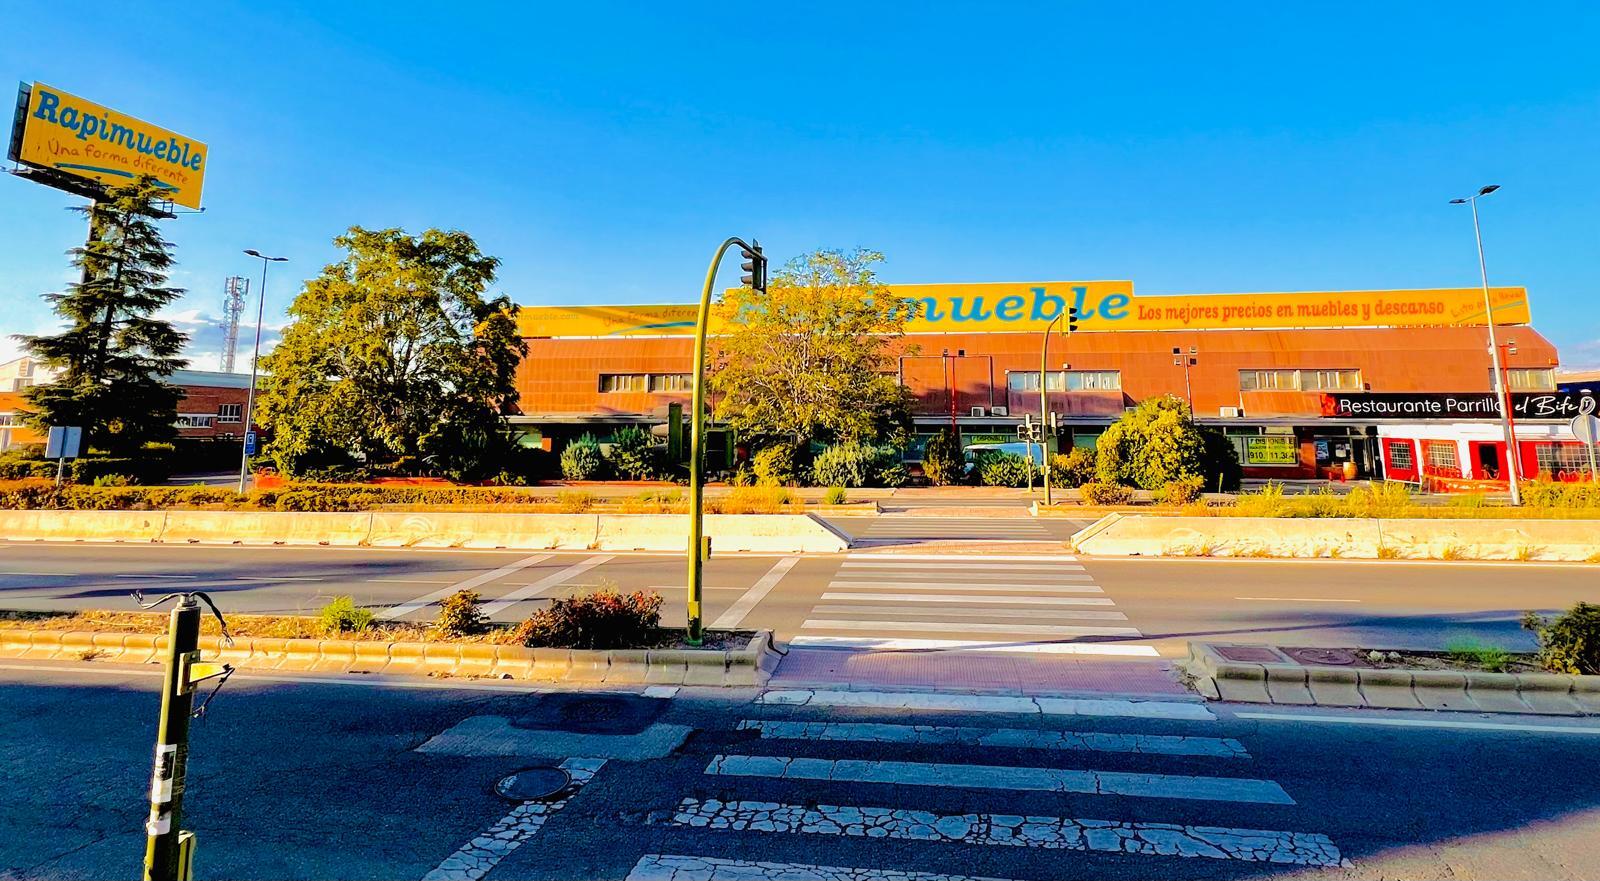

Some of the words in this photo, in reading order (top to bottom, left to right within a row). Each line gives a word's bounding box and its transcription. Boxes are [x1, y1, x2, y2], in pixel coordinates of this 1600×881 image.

[32, 90, 202, 171] Rapimueble
[84, 144, 129, 165] forma
[133, 155, 190, 185] diferente
[1138, 305, 1162, 321] Los
[1165, 303, 1219, 325] mejores
[1221, 302, 1273, 323] precios
[1275, 304, 1294, 318] en
[1296, 299, 1358, 318] muebles
[1361, 301, 1371, 322] y
[1374, 298, 1445, 317] descanso
[1340, 398, 1442, 414] Restaurante
[1514, 396, 1530, 414] el
[1531, 395, 1579, 416] Bife
